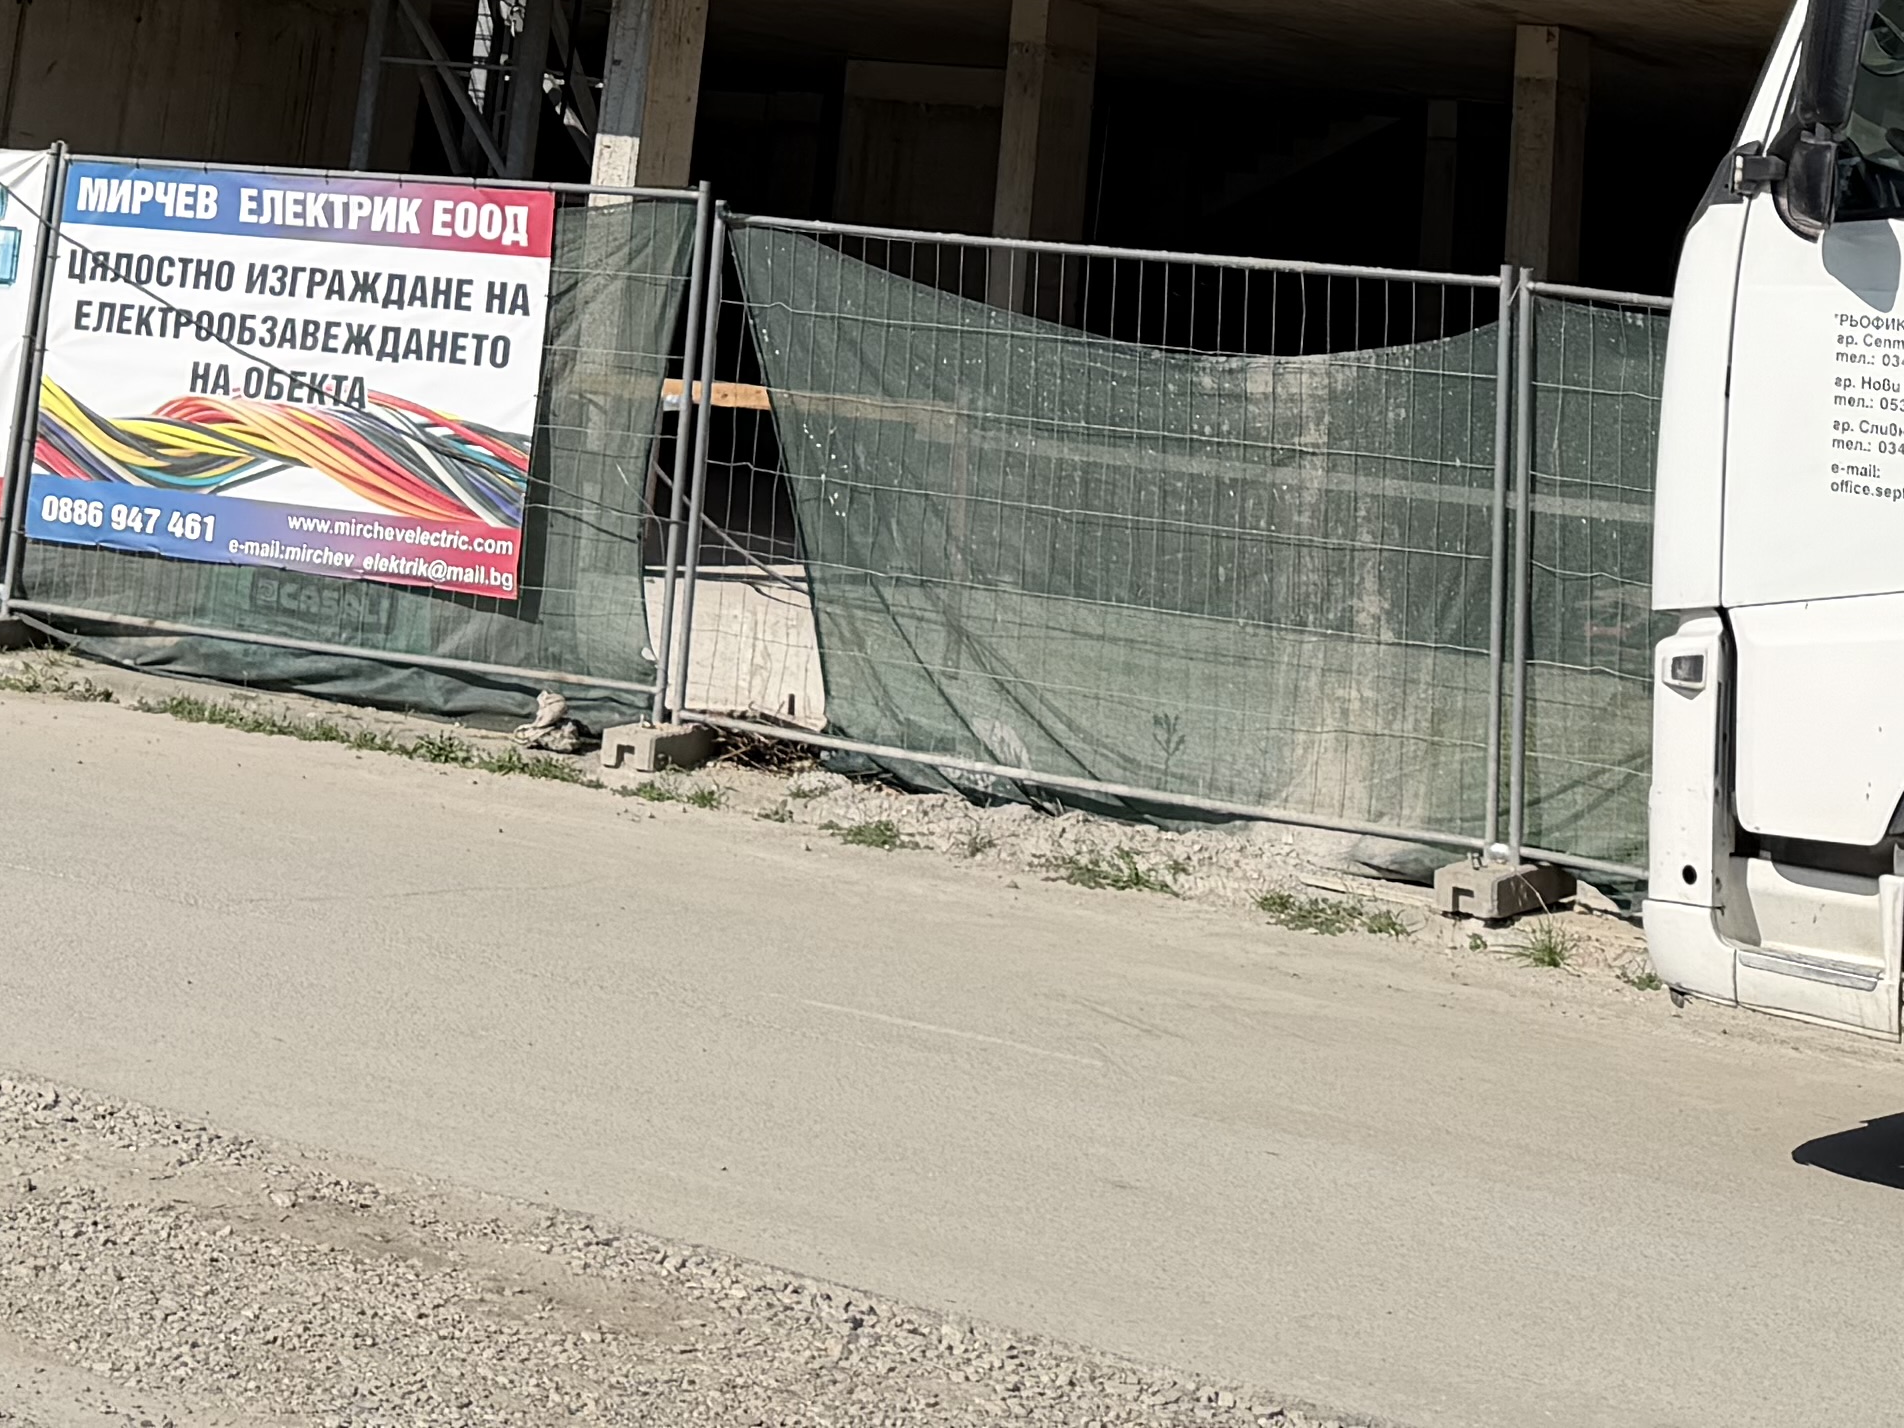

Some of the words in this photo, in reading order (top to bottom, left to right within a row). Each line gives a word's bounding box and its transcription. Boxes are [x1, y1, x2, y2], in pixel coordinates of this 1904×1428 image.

[76, 176, 218, 221] МИРЧЕВ
[238, 188, 422, 235] ЕЛЕКТРИК
[431, 200, 530, 247] ЕООД
[66, 247, 236, 294] ЦЯЛОСТНО
[244, 262, 476, 312] ИЗГРАЖДАНЕ
[485, 280, 531, 318] НА
[74, 299, 512, 369] ЕЛЕКТРООБЗАВЕЖДАНЕТО
[1837, 334, 1858, 348] гр.
[189, 361, 230, 397] НА
[243, 366, 367, 410] ОБЕКТА
[1834, 376, 1855, 391] гр.
[1861, 376, 1901, 393] Нови
[1833, 420, 1854, 434] гр.
[1831, 462, 1881, 479] e-mail:
[41, 494, 104, 526] 0886
[110, 503, 161, 534] 947
[167, 509, 217, 542] 461
[287, 513, 514, 556] www.mirchevelectric.com
